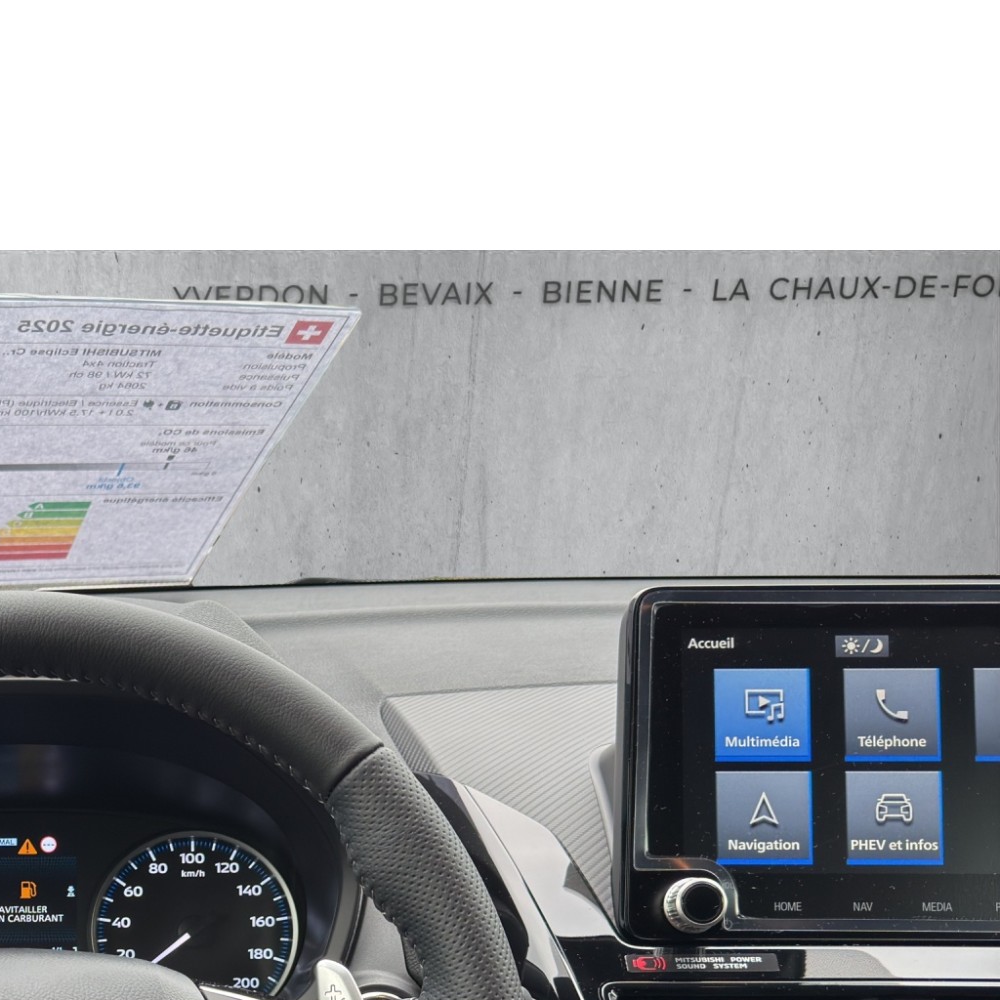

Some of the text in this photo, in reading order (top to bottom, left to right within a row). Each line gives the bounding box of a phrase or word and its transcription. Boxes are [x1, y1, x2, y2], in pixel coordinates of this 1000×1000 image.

[379, 282, 494, 306] BEVAIX
[542, 279, 664, 304] BIENNE
[712, 278, 750, 301] LA
[769, 274, 1000, 301] CHAUX-DE-FO
[688, 637, 735, 651] Accueil
[724, 734, 801, 748] Multimédia
[857, 734, 927, 751] Téléphone
[727, 838, 801, 855] Navigation
[850, 838, 939, 851] PHEV et infos
[179, 853, 205, 864] 100
[148, 863, 168, 874] 80
[215, 862, 240, 873] 120
[181, 869, 205, 878] km/h
[123, 886, 143, 897] 60
[236, 885, 262, 896] 140
[774, 902, 802, 912] HOME
[853, 902, 873, 912] NAV
[922, 902, 953, 912] MEDIA
[7, 914, 64, 923] CARBURANT
[111, 917, 131, 929] 40
[250, 916, 275, 928] 160
[116, 949, 136, 959] 20
[247, 948, 274, 960] 180
[233, 977, 260, 989] 200
